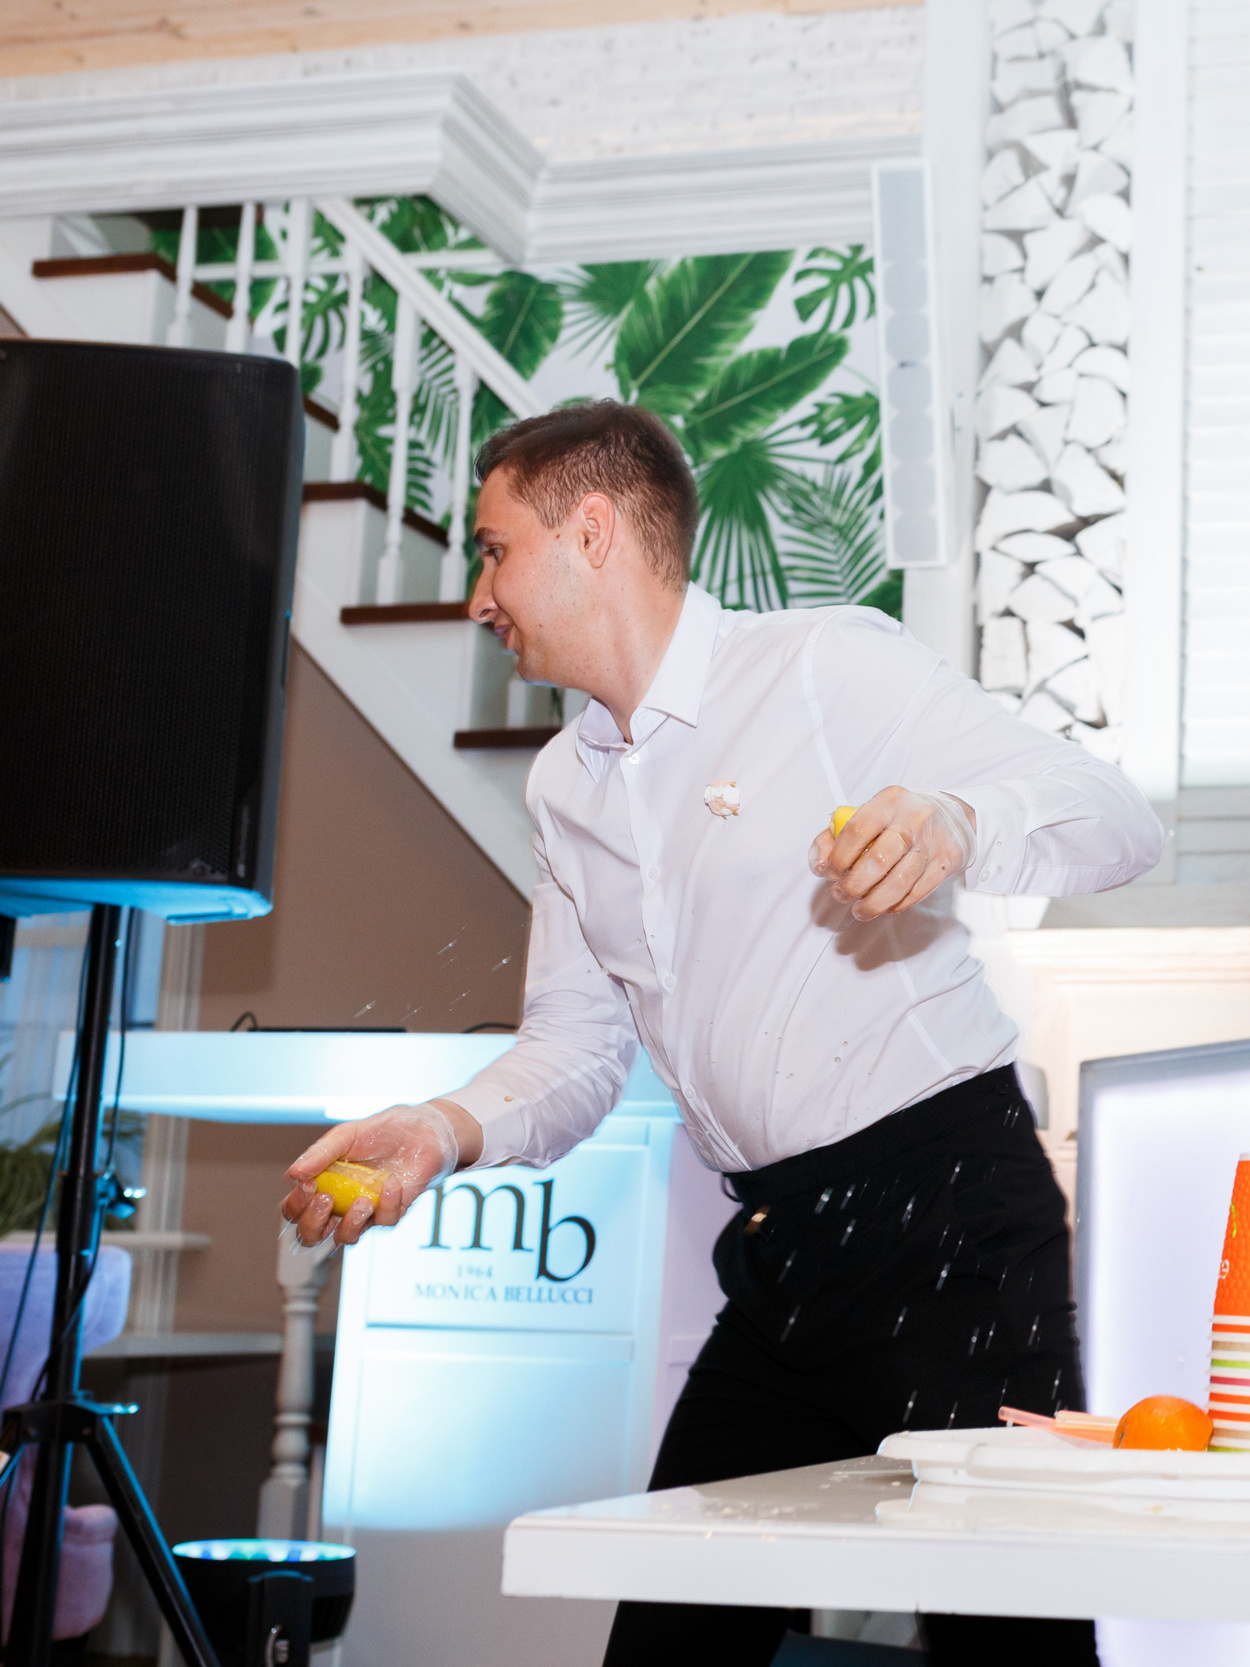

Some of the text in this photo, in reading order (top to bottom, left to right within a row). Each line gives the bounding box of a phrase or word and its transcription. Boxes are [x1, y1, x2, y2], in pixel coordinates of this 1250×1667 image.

[418, 1178, 597, 1283] mb
[456, 1265, 494, 1280] 1964
[414, 1282, 594, 1305] MONICA BELLUCCI
